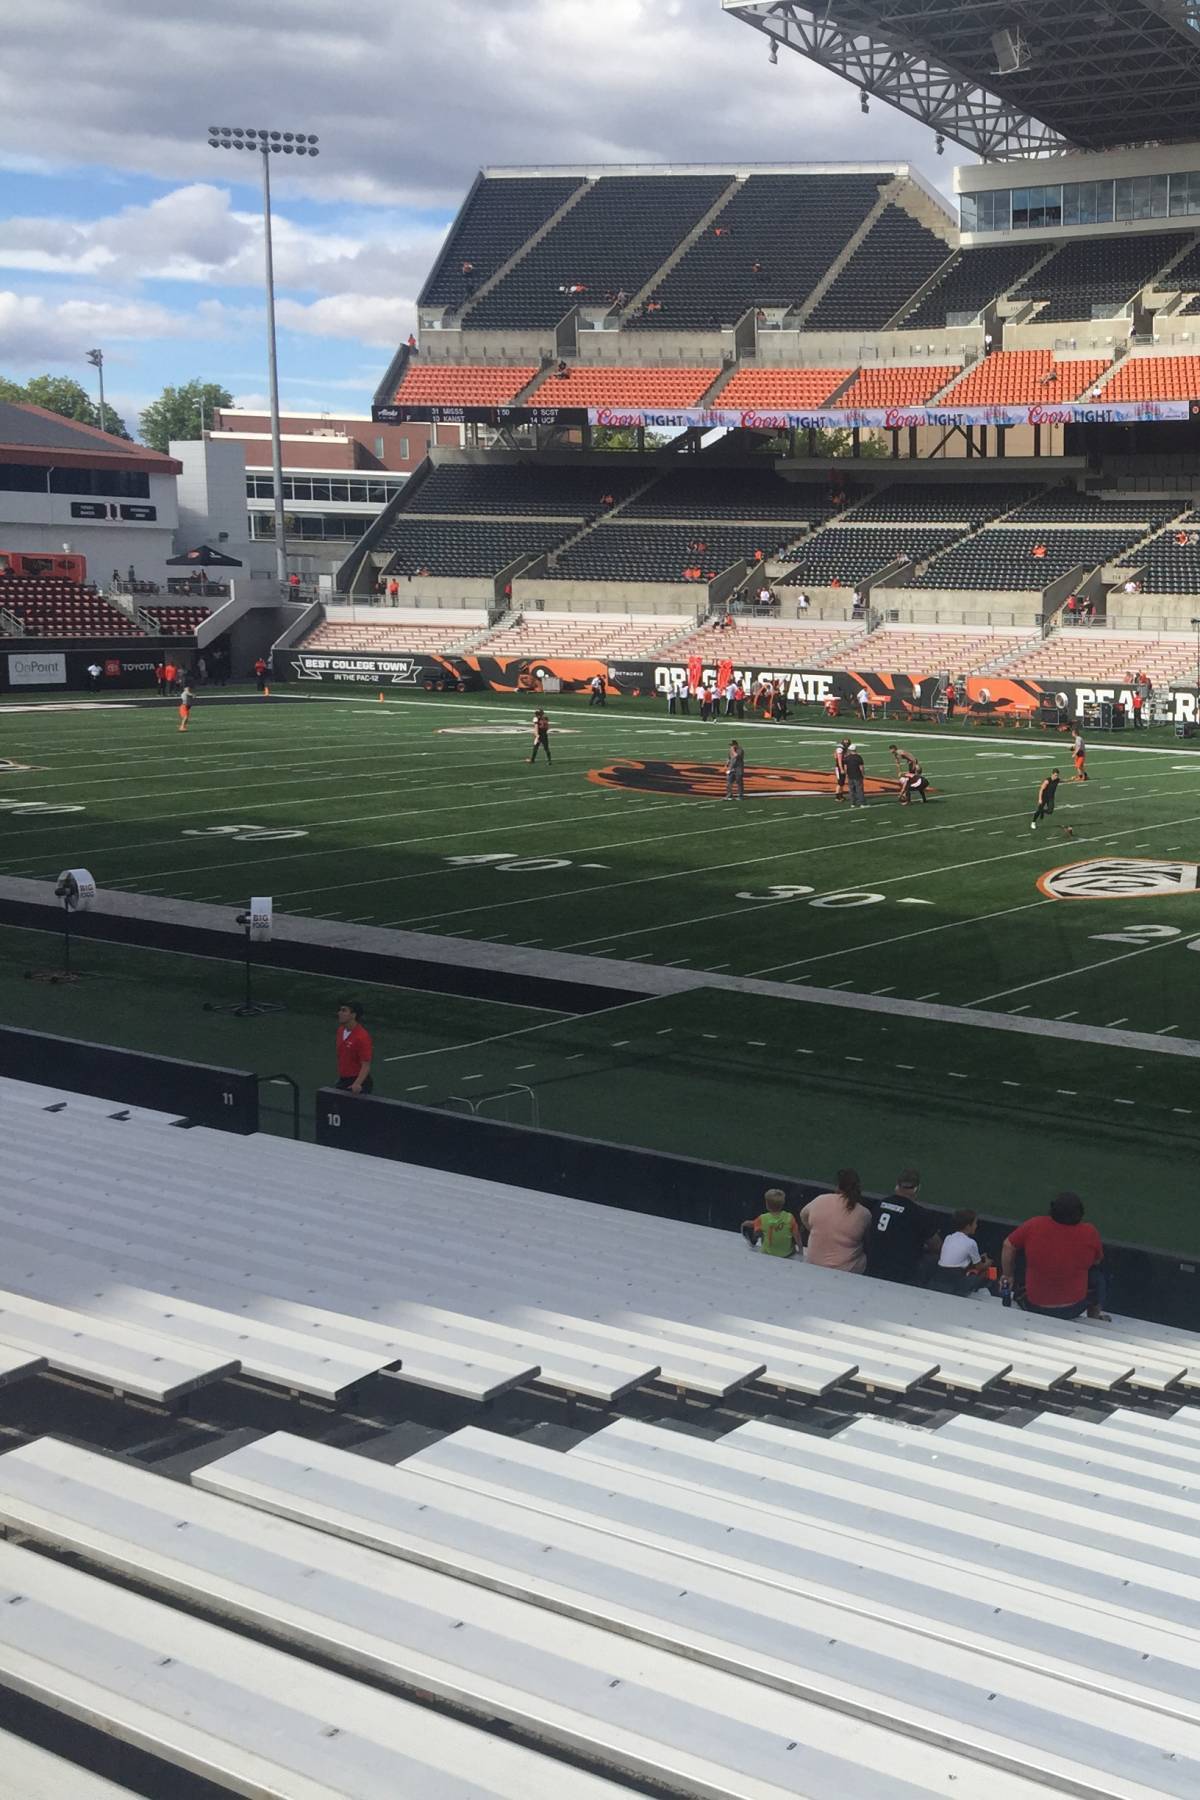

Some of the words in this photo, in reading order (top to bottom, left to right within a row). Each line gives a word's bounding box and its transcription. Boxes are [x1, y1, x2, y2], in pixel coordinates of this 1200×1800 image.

[597, 407, 642, 427] Coors
[645, 414, 684, 427] LIGHT
[741, 409, 788, 429] Coors
[789, 415, 825, 428] LIGHT
[885, 408, 925, 427] Coors
[927, 413, 964, 426] LIGHT
[1027, 406, 1072, 425] Coors
[1073, 409, 1113, 423] LIGHT
[15, 661, 59, 673] OnPoint
[122, 663, 155, 671] TOYOTA
[305, 658, 331, 669] BEST
[332, 659, 375, 671] COLLEGE
[377, 661, 408, 672] TOWN
[654, 666, 753, 696] ORGN
[181, 825, 309, 841] 50
[442, 853, 573, 872] 40
[79, 884, 94, 892] BIG
[735, 885, 886, 908] 30
[252, 914, 269, 922] BIG
[222, 1092, 234, 1105] 11
[327, 1113, 341, 1127] 10
[877, 1212, 891, 1232] 9
